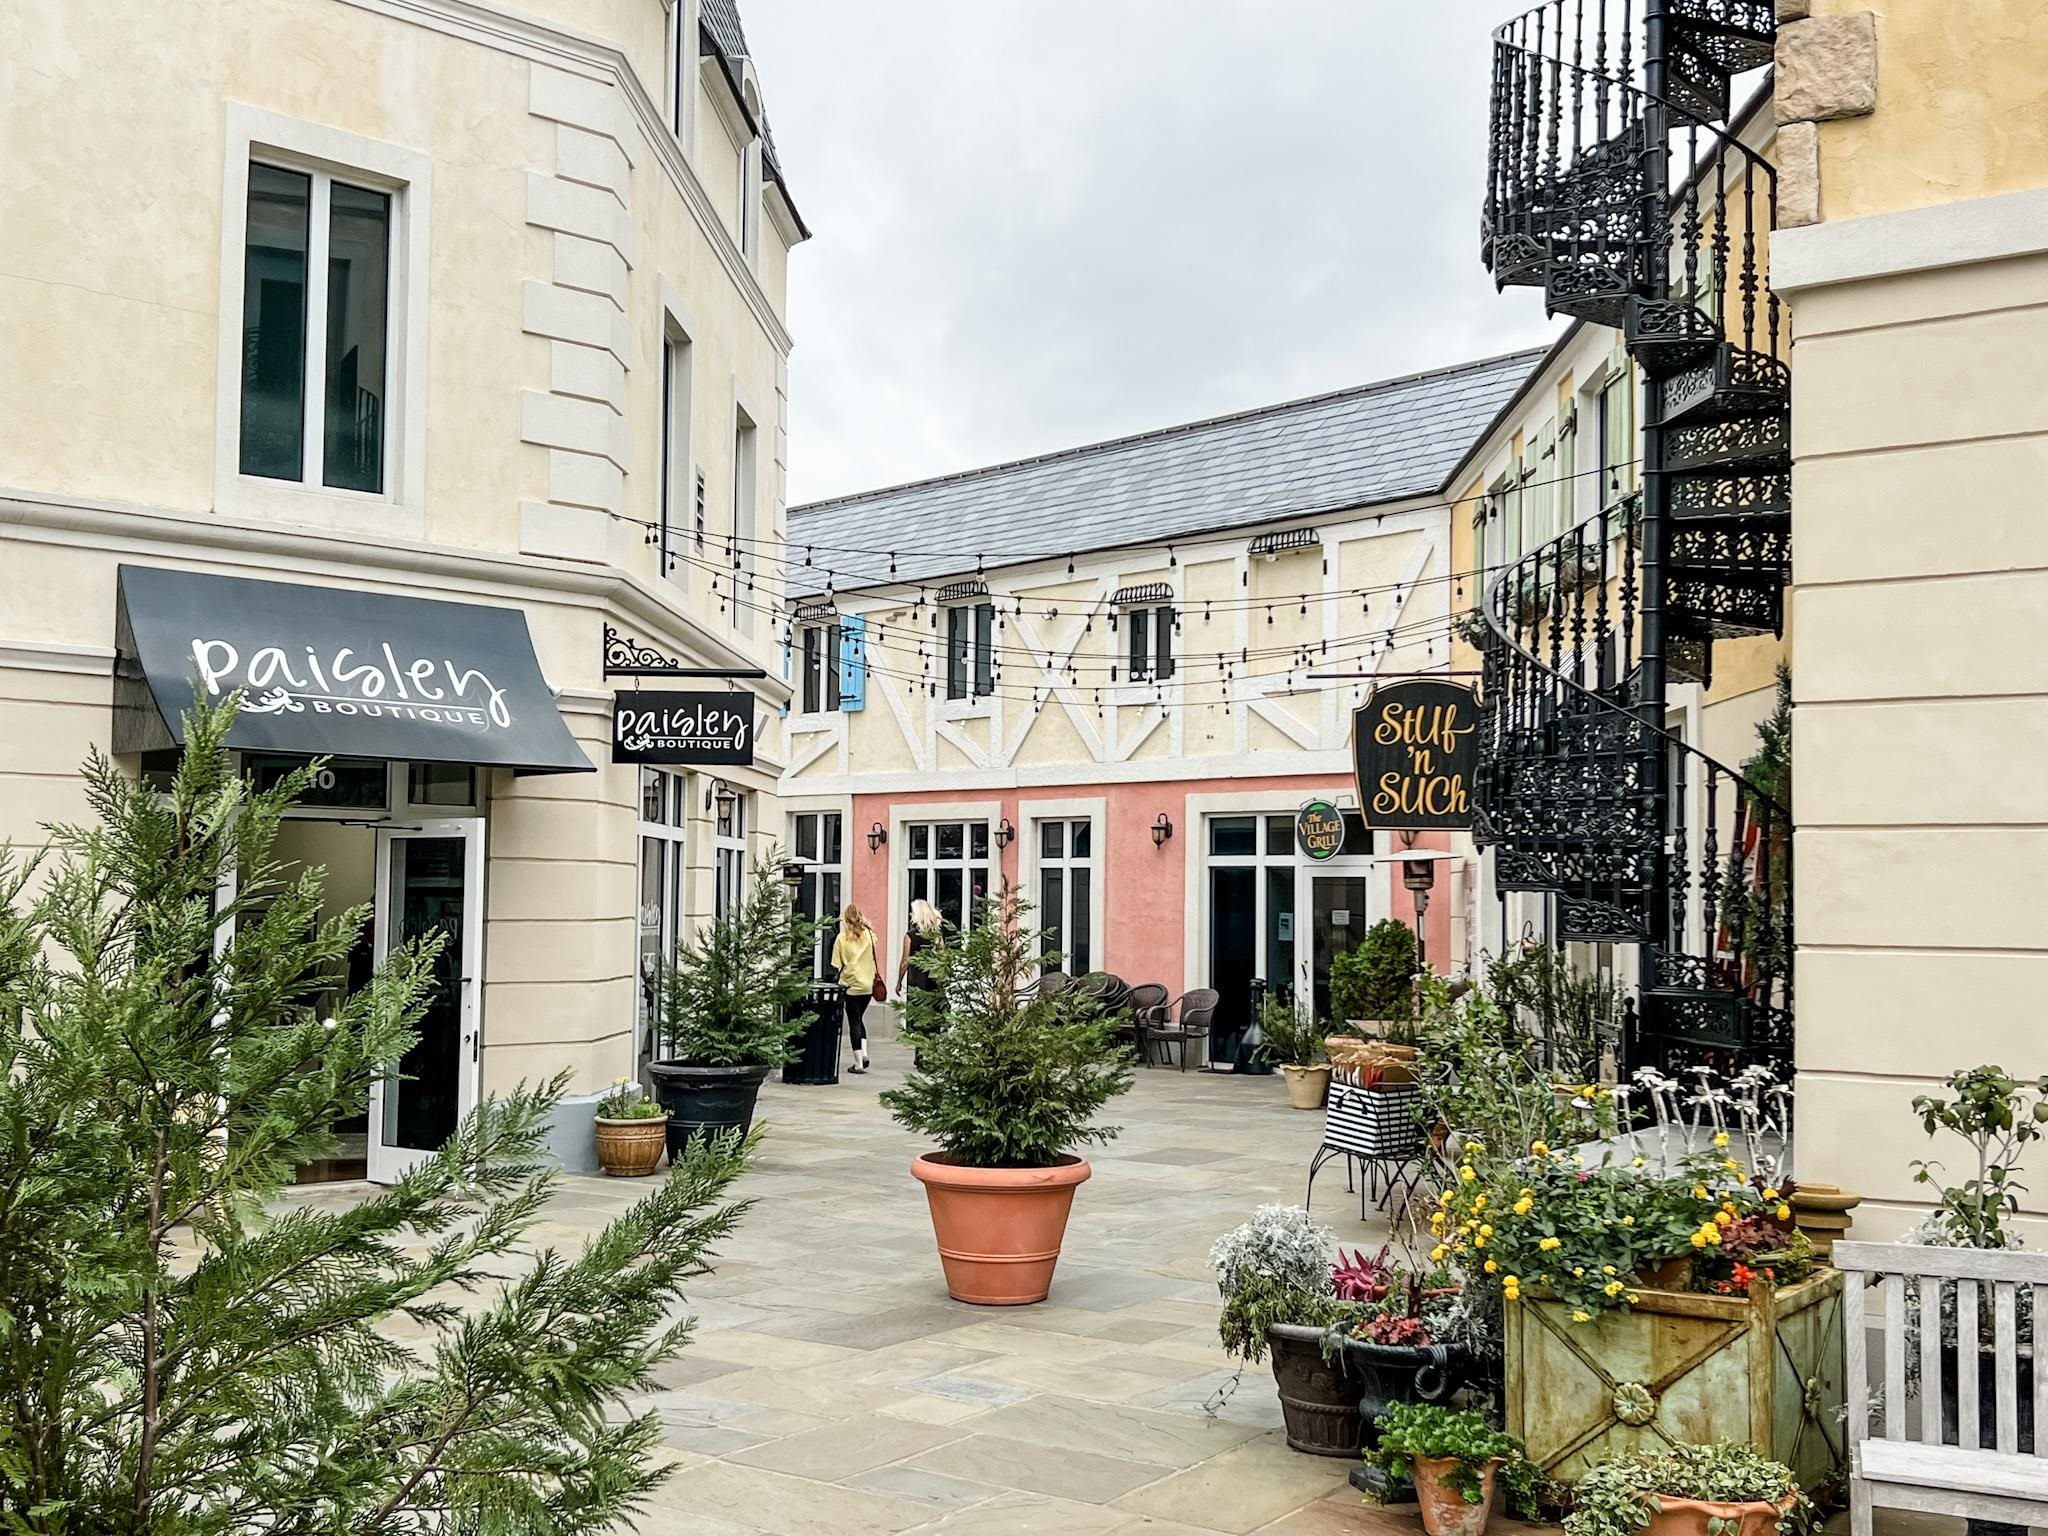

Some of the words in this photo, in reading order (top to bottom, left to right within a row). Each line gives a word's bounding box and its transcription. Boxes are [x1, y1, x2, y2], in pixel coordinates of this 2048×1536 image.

[192, 638, 511, 728] paisley
[311, 700, 486, 727] BOUTIQUE
[616, 703, 749, 751] paisley
[657, 739, 731, 750] BOUTIQUE
[1299, 820, 1342, 836] VILLAGE
[1307, 834, 1339, 850] GRILL
